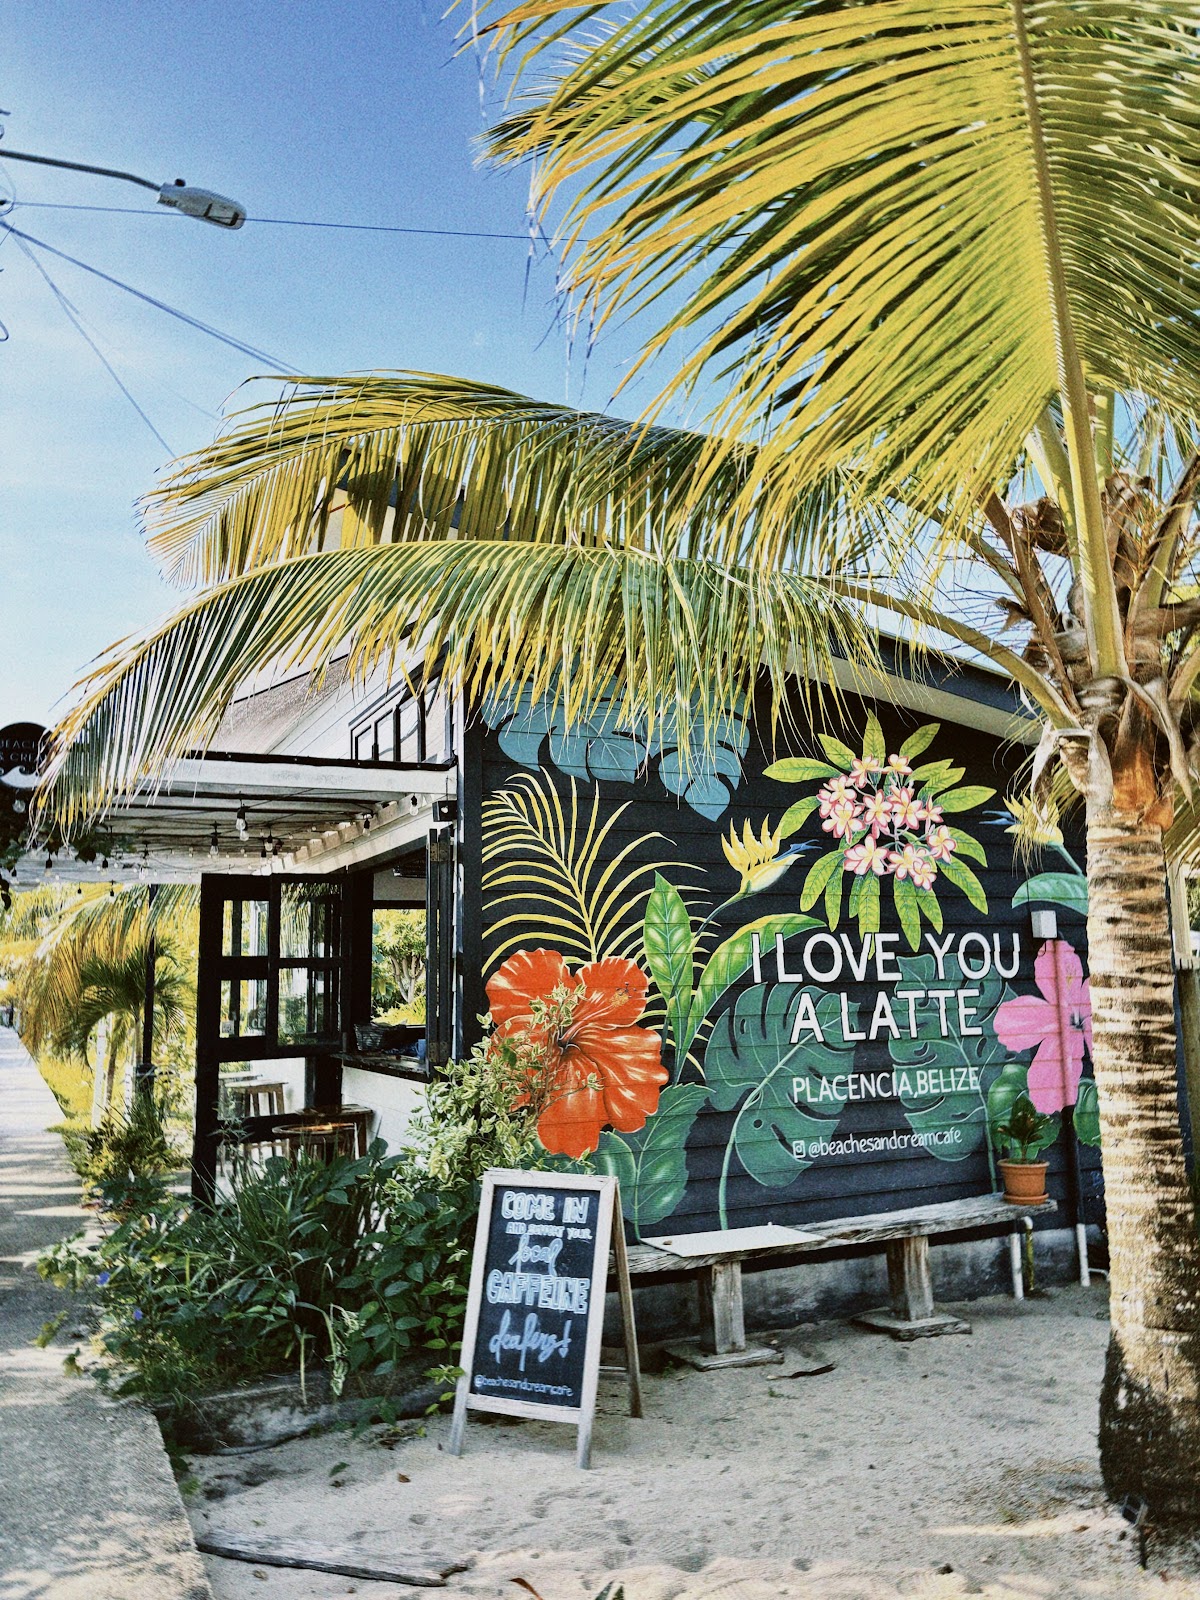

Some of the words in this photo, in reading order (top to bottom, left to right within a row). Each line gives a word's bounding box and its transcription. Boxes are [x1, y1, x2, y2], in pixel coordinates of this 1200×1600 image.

[751, 933, 762, 984] I
[775, 932, 902, 984] LOVE
[924, 932, 1020, 981] YOU
[790, 992, 825, 1044] A
[839, 988, 983, 1043] LATTE
[808, 1126, 962, 1158] @beachesandcreamcafe
[501, 1190, 556, 1221] COME
[562, 1196, 589, 1224] IN
[505, 1221, 527, 1235] AND
[527, 1223, 565, 1238] SUPPORT
[566, 1227, 593, 1240] YOUR
[508, 1233, 564, 1277] local
[486, 1269, 591, 1315] CAFFEINE
